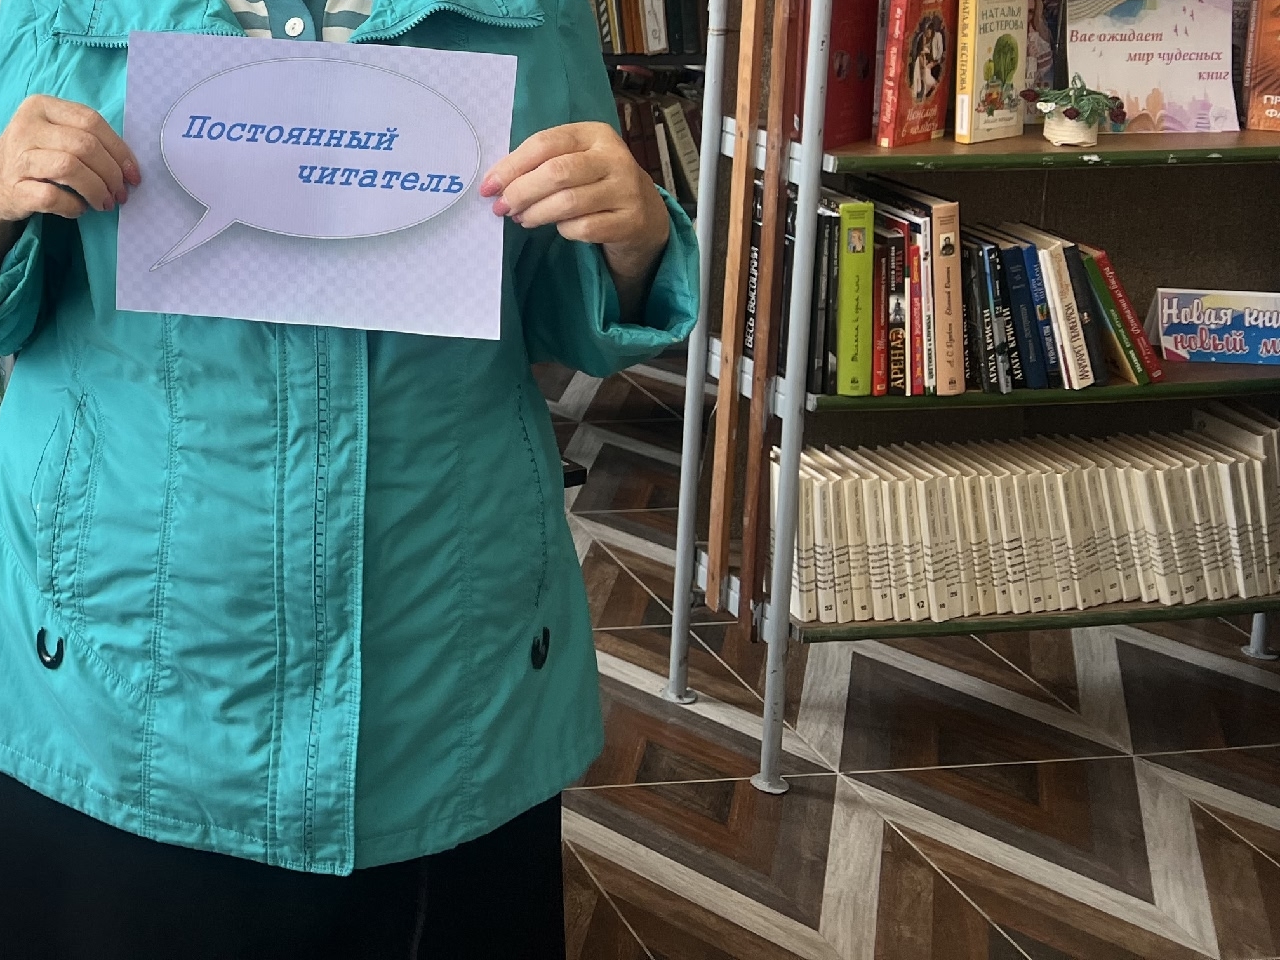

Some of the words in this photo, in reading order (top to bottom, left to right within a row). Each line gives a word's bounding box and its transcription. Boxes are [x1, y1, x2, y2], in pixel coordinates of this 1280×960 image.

[979, 19, 1024, 35] НЕСТЕРОВА
[981, 6, 1022, 21] НАТАЛЬЯ
[1098, 28, 1164, 43] ожидает
[959, 41, 969, 91] НЕСТЕРОВА
[1126, 52, 1154, 66] мир
[1158, 47, 1223, 66] чудесных
[1198, 71, 1230, 81] книг
[181, 114, 400, 152] Постоянный
[296, 163, 465, 195] читатель
[1162, 296, 1234, 326] Новая
[983, 308, 994, 350] КРИСТИ
[1172, 325, 1250, 355] новый
[987, 353, 998, 384] АГАТА
